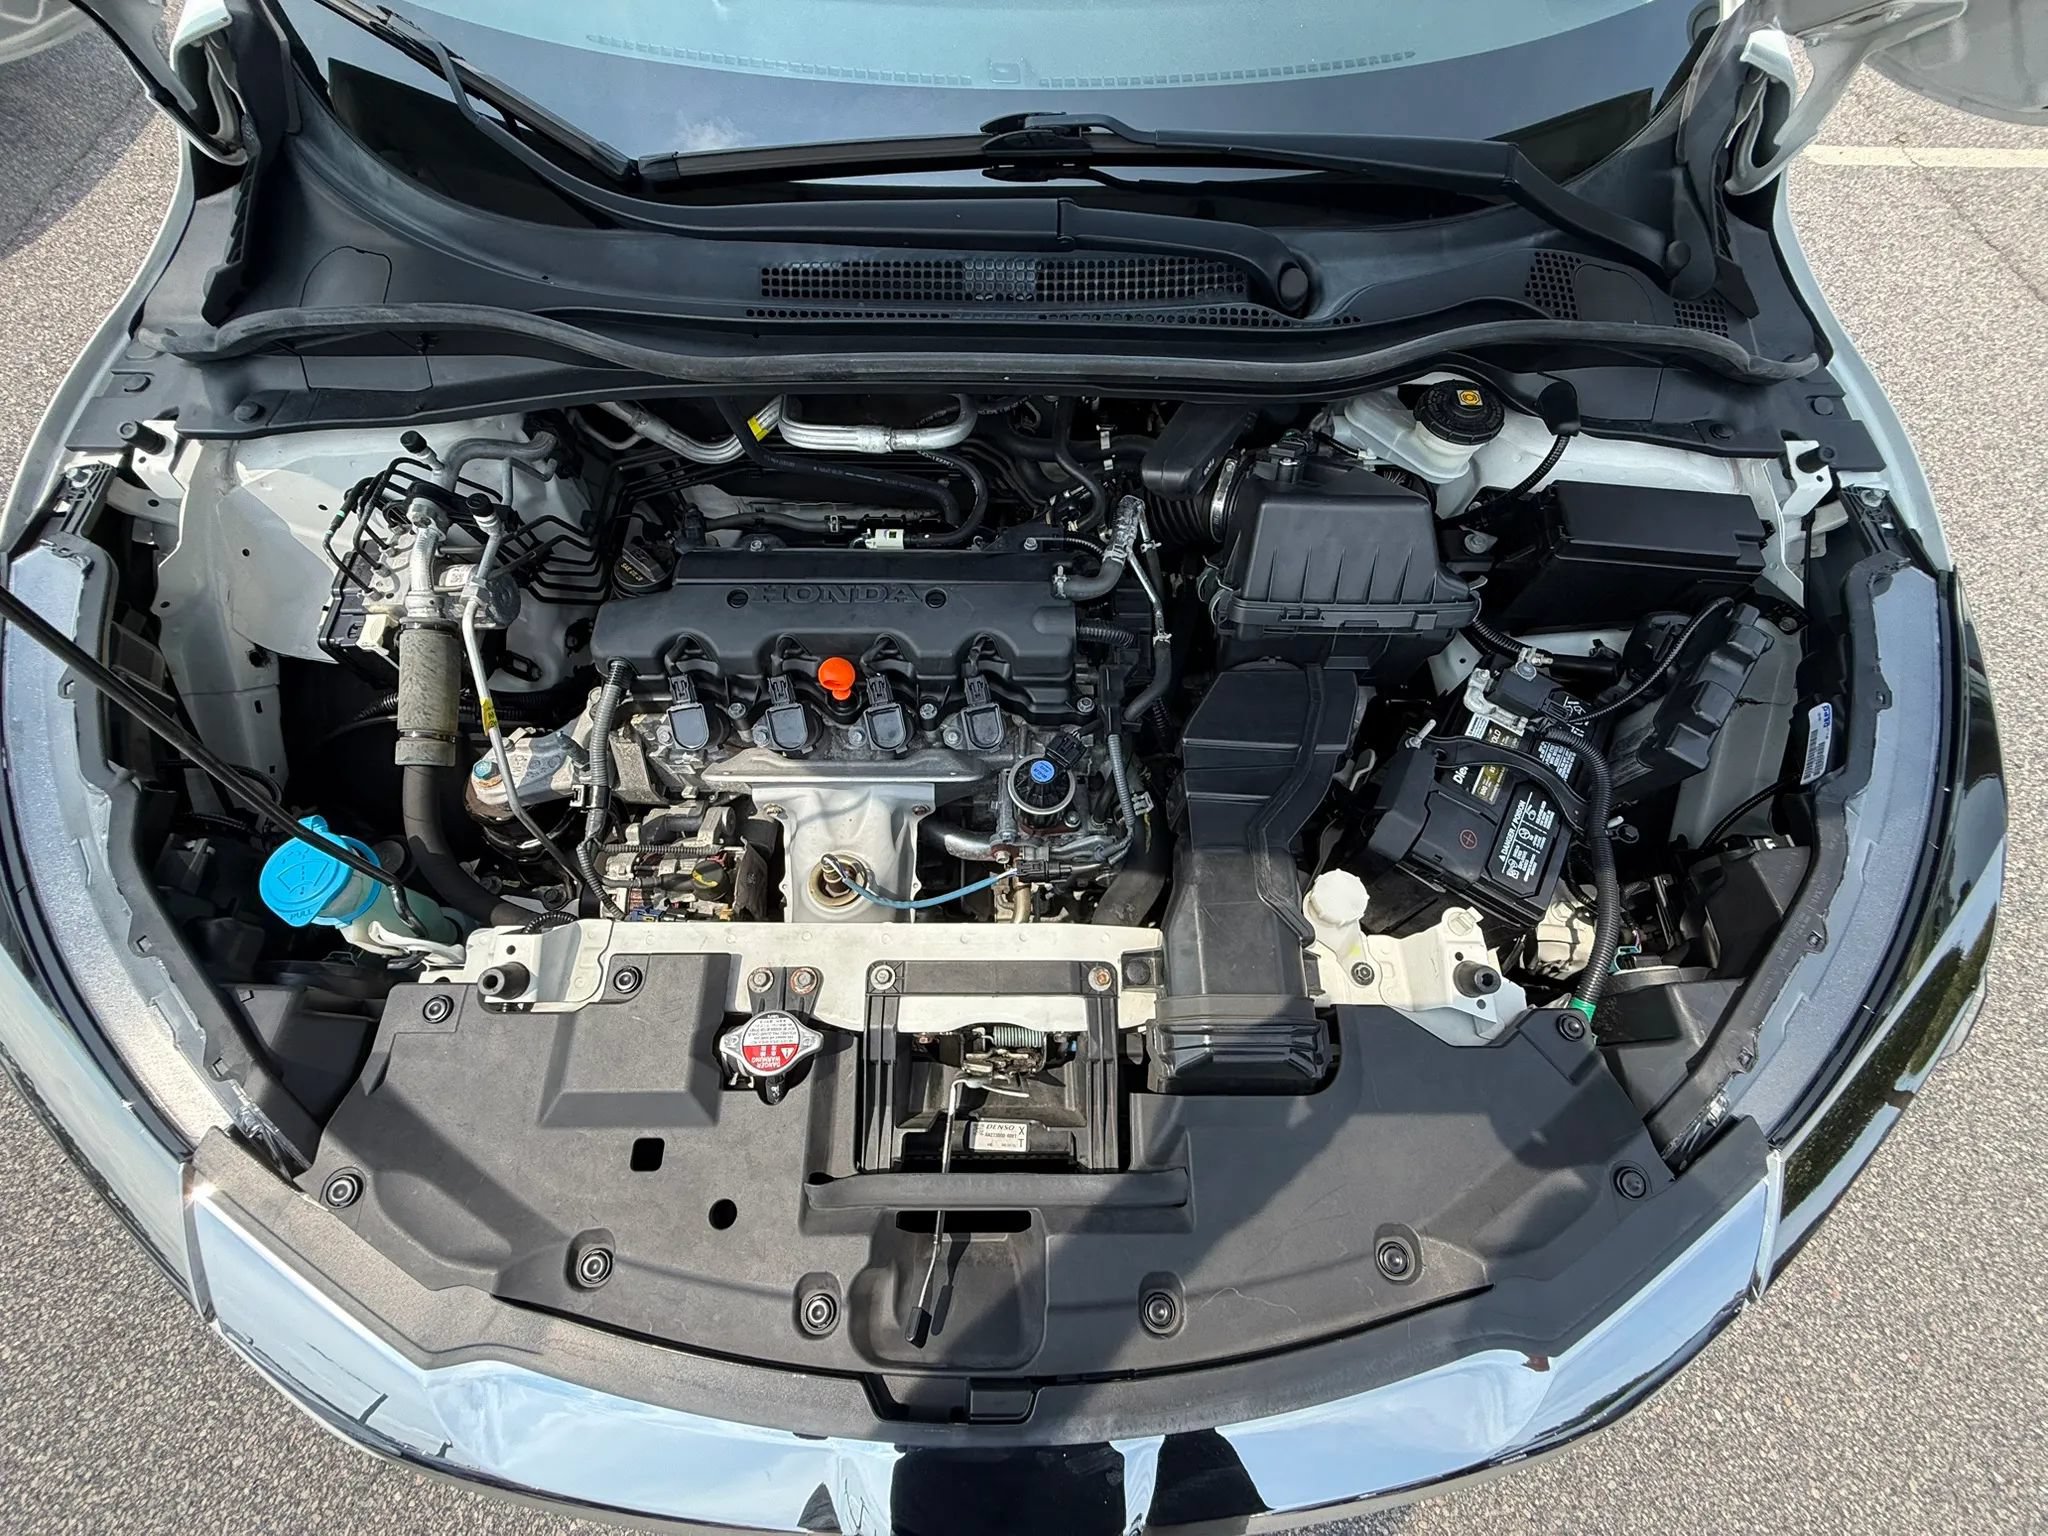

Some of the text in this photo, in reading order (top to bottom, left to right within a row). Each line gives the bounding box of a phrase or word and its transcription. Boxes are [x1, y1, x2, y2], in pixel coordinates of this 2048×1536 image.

[751, 584, 922, 604] HONDA
[1489, 728, 1501, 743] OLD
[1501, 828, 1515, 854] DANGER
[1512, 799, 1526, 823] POISON
[290, 909, 312, 920] PULL
[985, 1123, 1015, 1131] DENSO
[1018, 1126, 1025, 1135] X
[1017, 1138, 1024, 1147] T
